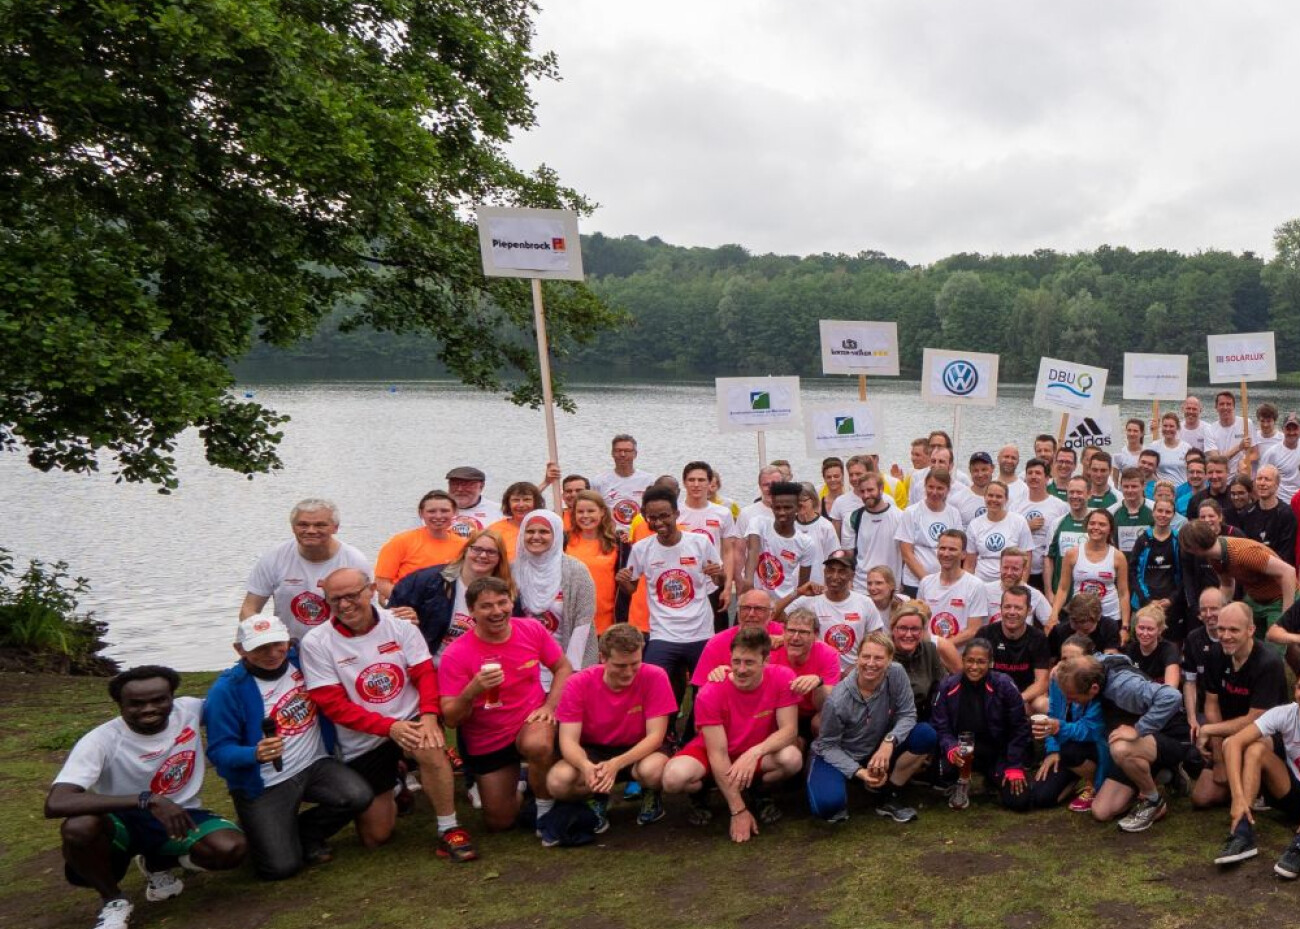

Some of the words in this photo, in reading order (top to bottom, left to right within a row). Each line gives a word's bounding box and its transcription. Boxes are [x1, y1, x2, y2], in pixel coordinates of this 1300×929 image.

[492, 239, 550, 250] Piepenbrock
[1226, 353, 1266, 362] SOLARLUX
[1049, 369, 1076, 384] DBU
[1065, 436, 1112, 449] adidas
